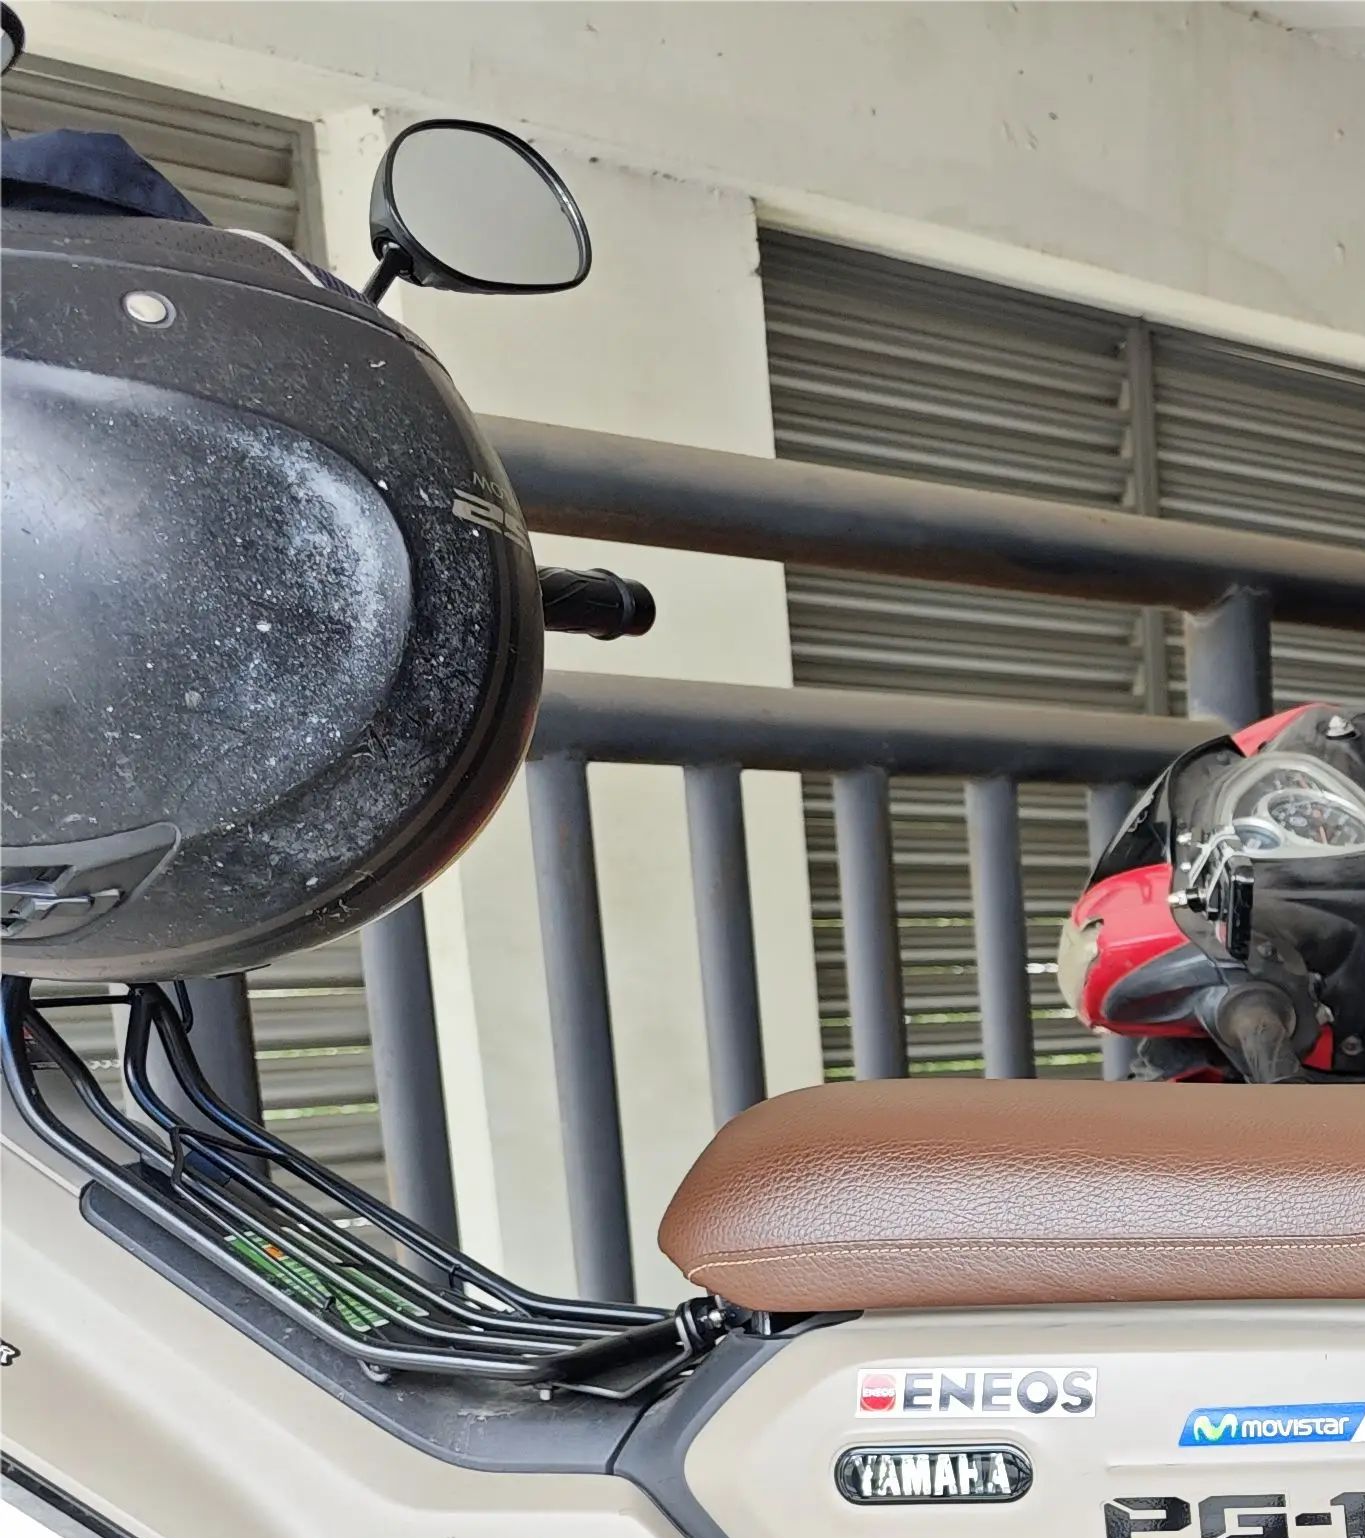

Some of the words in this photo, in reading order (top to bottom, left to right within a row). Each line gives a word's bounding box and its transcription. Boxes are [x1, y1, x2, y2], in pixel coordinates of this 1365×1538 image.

[862, 1387, 896, 1399] ENEOS
[902, 1371, 1094, 1414] ENEOS
[1241, 1416, 1350, 1438] movistar
[851, 1452, 1012, 1497] YAMAHA
